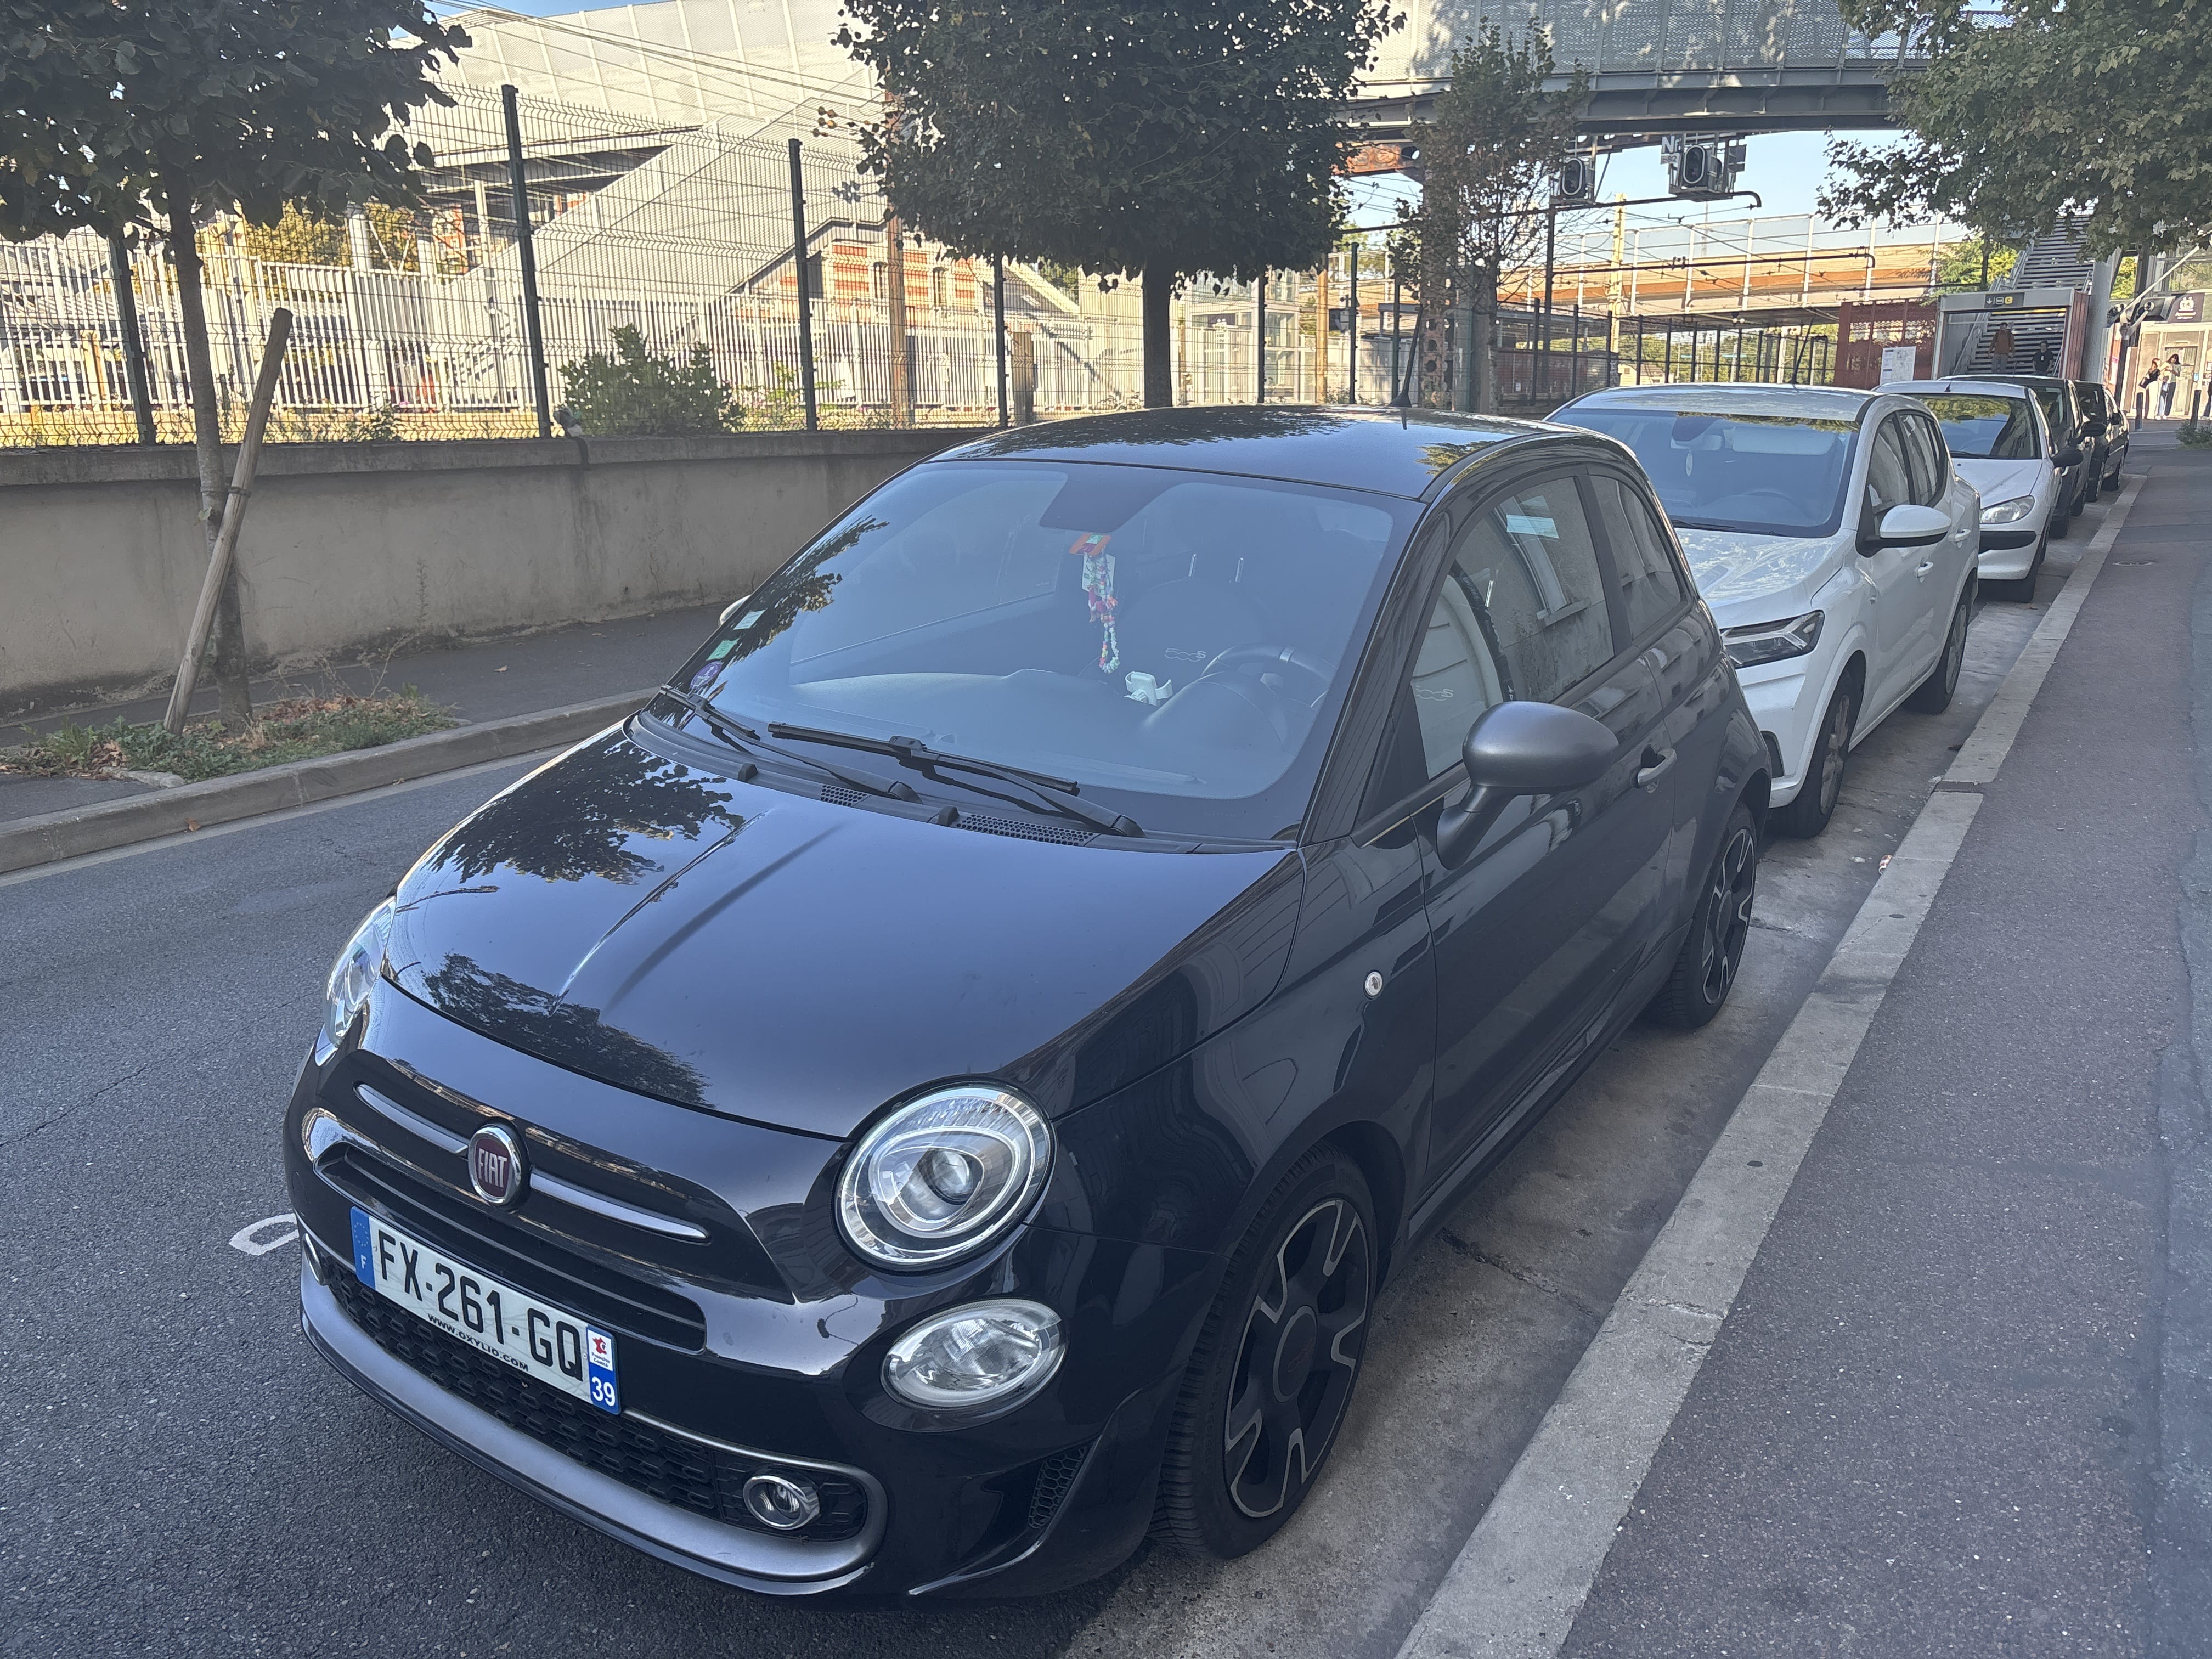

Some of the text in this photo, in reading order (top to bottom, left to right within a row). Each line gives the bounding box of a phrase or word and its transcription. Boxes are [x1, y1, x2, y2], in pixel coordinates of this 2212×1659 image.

[478, 1148, 507, 1188] FIAT
[360, 1254, 367, 1269] F
[378, 1229, 583, 1382] FX-261-GQ
[427, 1313, 529, 1372] WWW.OXYLIO.COM
[591, 1376, 616, 1407] 39
